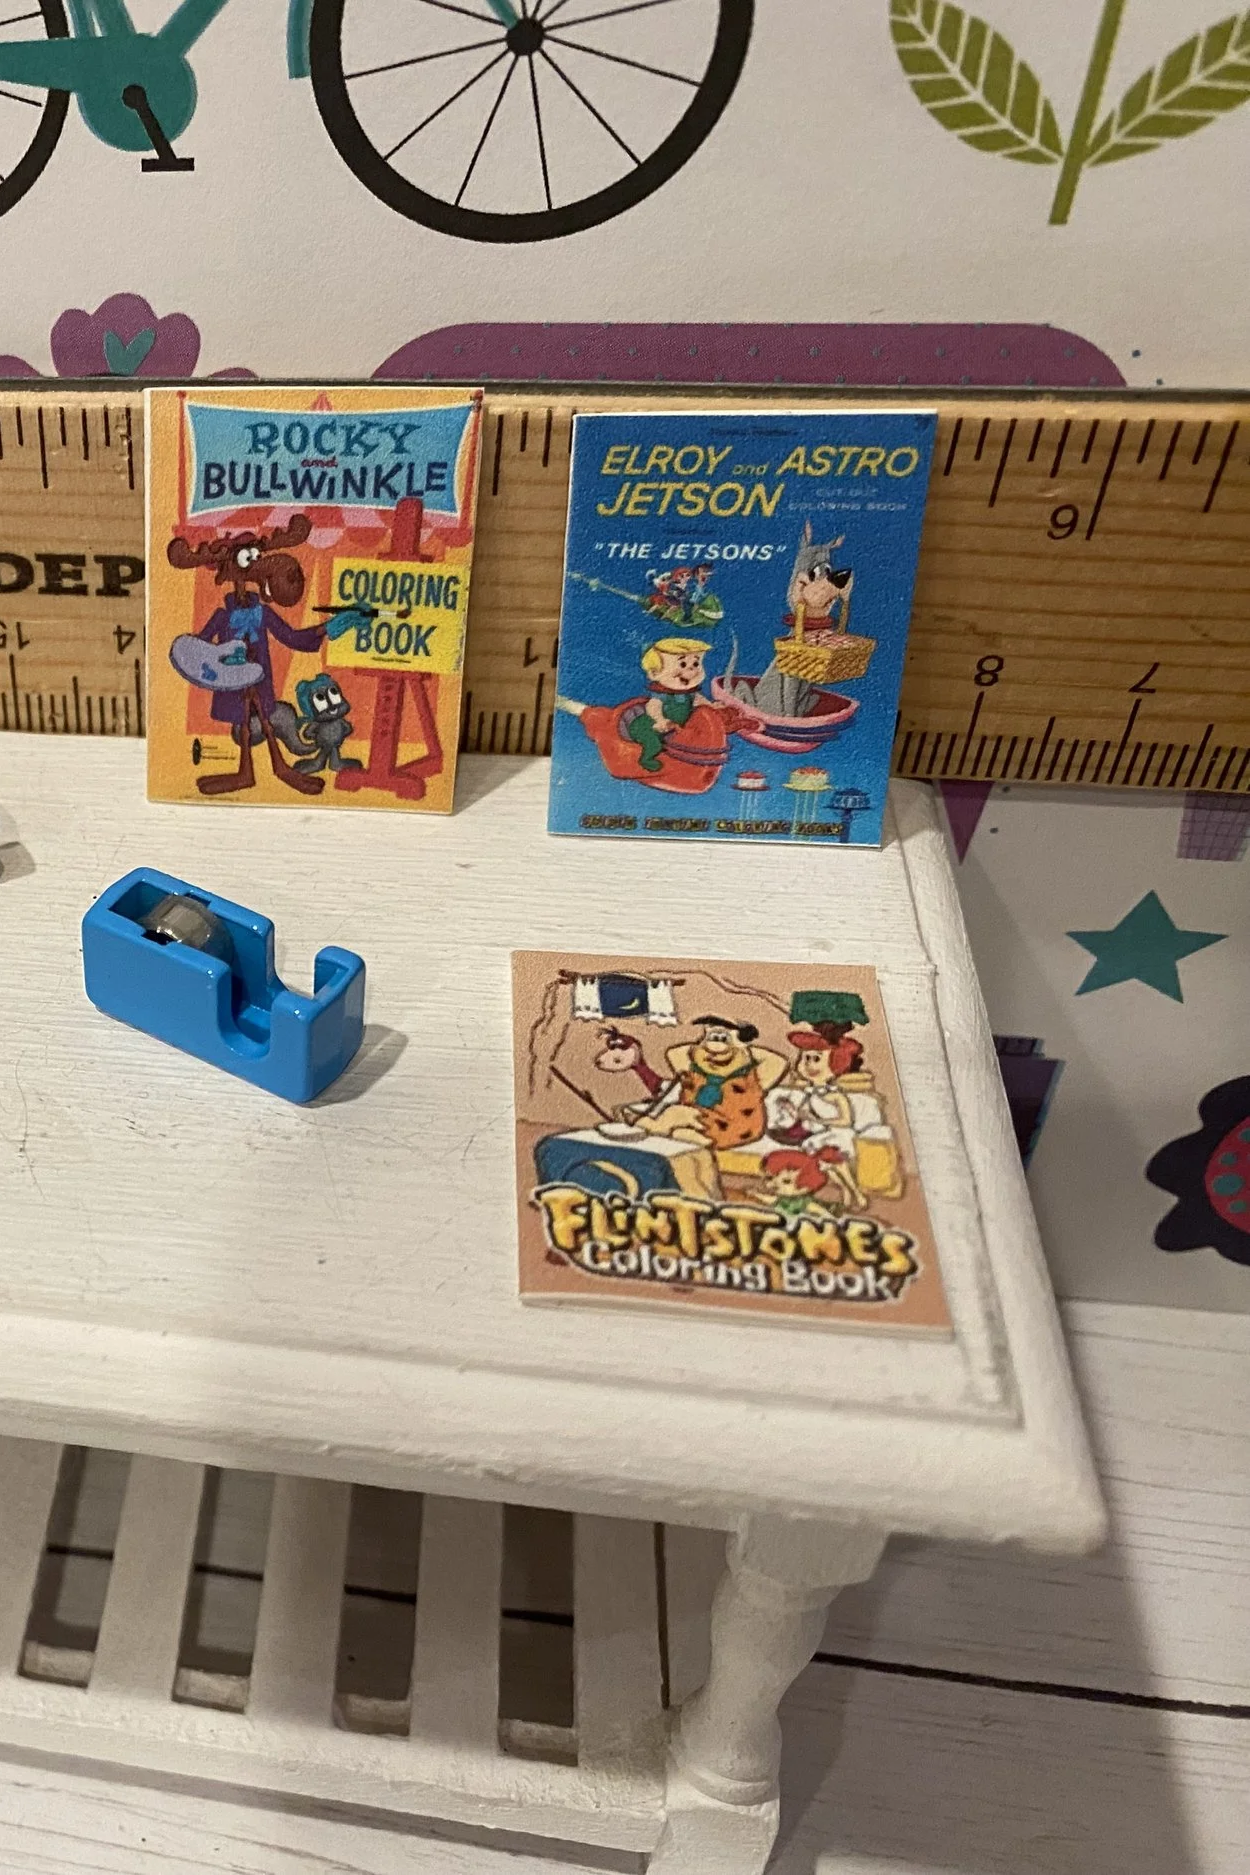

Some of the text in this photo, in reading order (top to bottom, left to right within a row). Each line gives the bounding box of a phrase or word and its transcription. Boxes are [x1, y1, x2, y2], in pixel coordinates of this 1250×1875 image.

[243, 419, 423, 458] ROCKY
[301, 455, 339, 468] and
[601, 444, 919, 477] ELROY and ASTRO
[203, 460, 448, 500] BULLWINKLE
[597, 481, 785, 518] JETSON
[1046, 503, 1080, 541] 9
[338, 568, 461, 611] COLORING
[112, 624, 145, 655] 4
[354, 621, 438, 657] BOOK
[974, 654, 1004, 687] 8
[1127, 661, 1160, 694] 7
[581, 1240, 895, 1299] Coloring Book
